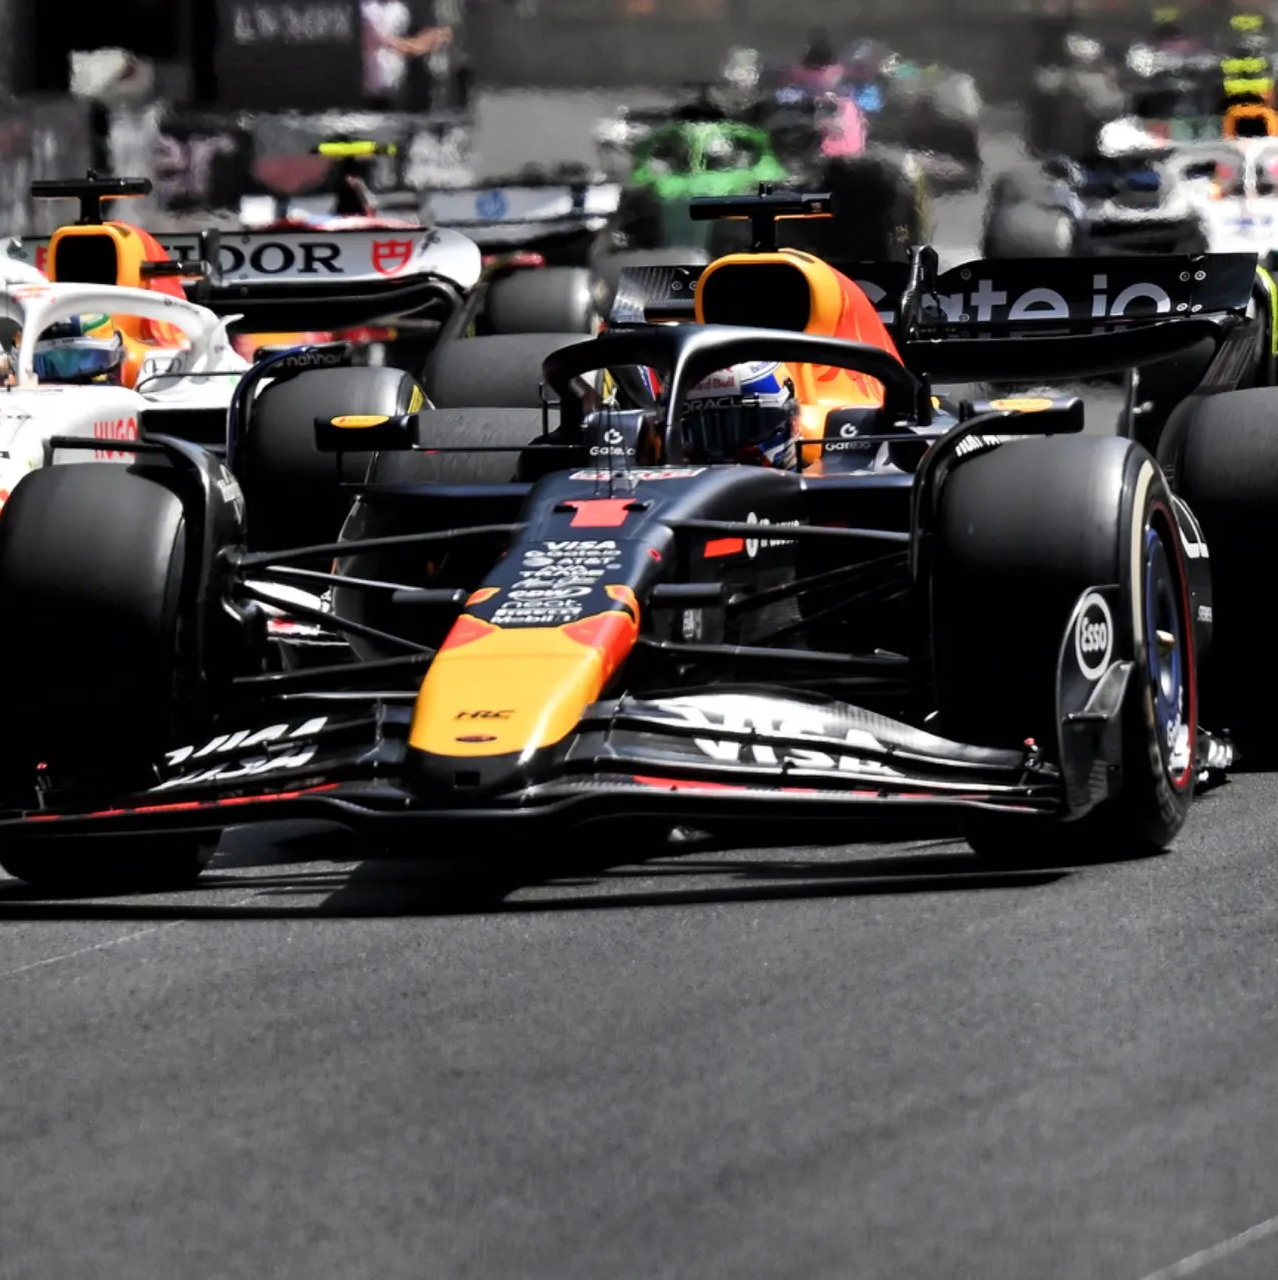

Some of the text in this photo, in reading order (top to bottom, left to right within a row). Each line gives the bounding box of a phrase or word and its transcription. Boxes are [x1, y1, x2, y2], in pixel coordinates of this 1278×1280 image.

[565, 498, 637, 528] 1
[543, 540, 617, 551] VISA
[1081, 616, 1107, 653] Esso
[454, 709, 516, 720] HRC
